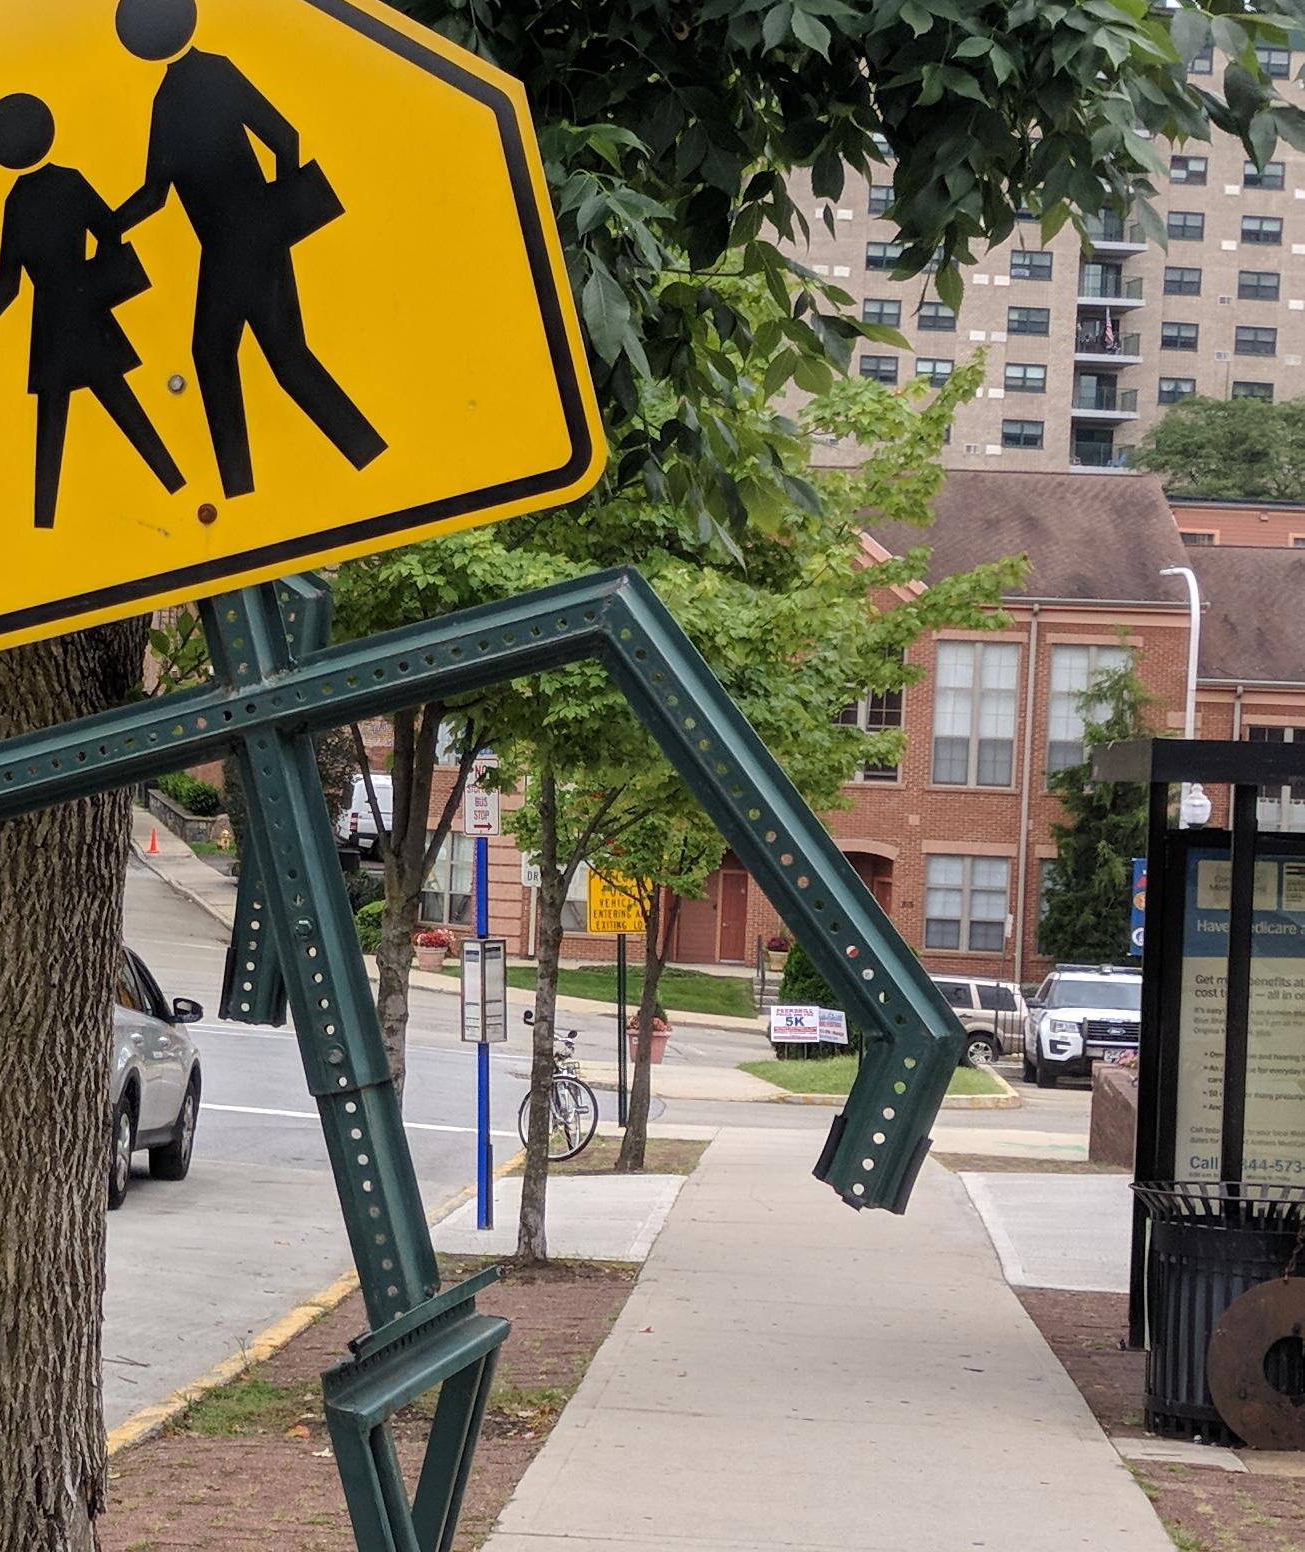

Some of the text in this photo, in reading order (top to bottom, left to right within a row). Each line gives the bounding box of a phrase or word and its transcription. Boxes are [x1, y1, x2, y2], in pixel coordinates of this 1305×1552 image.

[475, 797, 488, 806] BUS
[473, 810, 489, 820] STOP
[593, 909, 632, 919] ENTERING
[596, 920, 627, 930] EXITING
[1197, 920, 1297, 935] Have dicare
[1195, 974, 1214, 985] Get
[1195, 988, 1218, 999] cost
[1281, 990, 1292, 1000] in
[785, 1017, 805, 1027] 5K
[1190, 1156, 1218, 1170] Call
